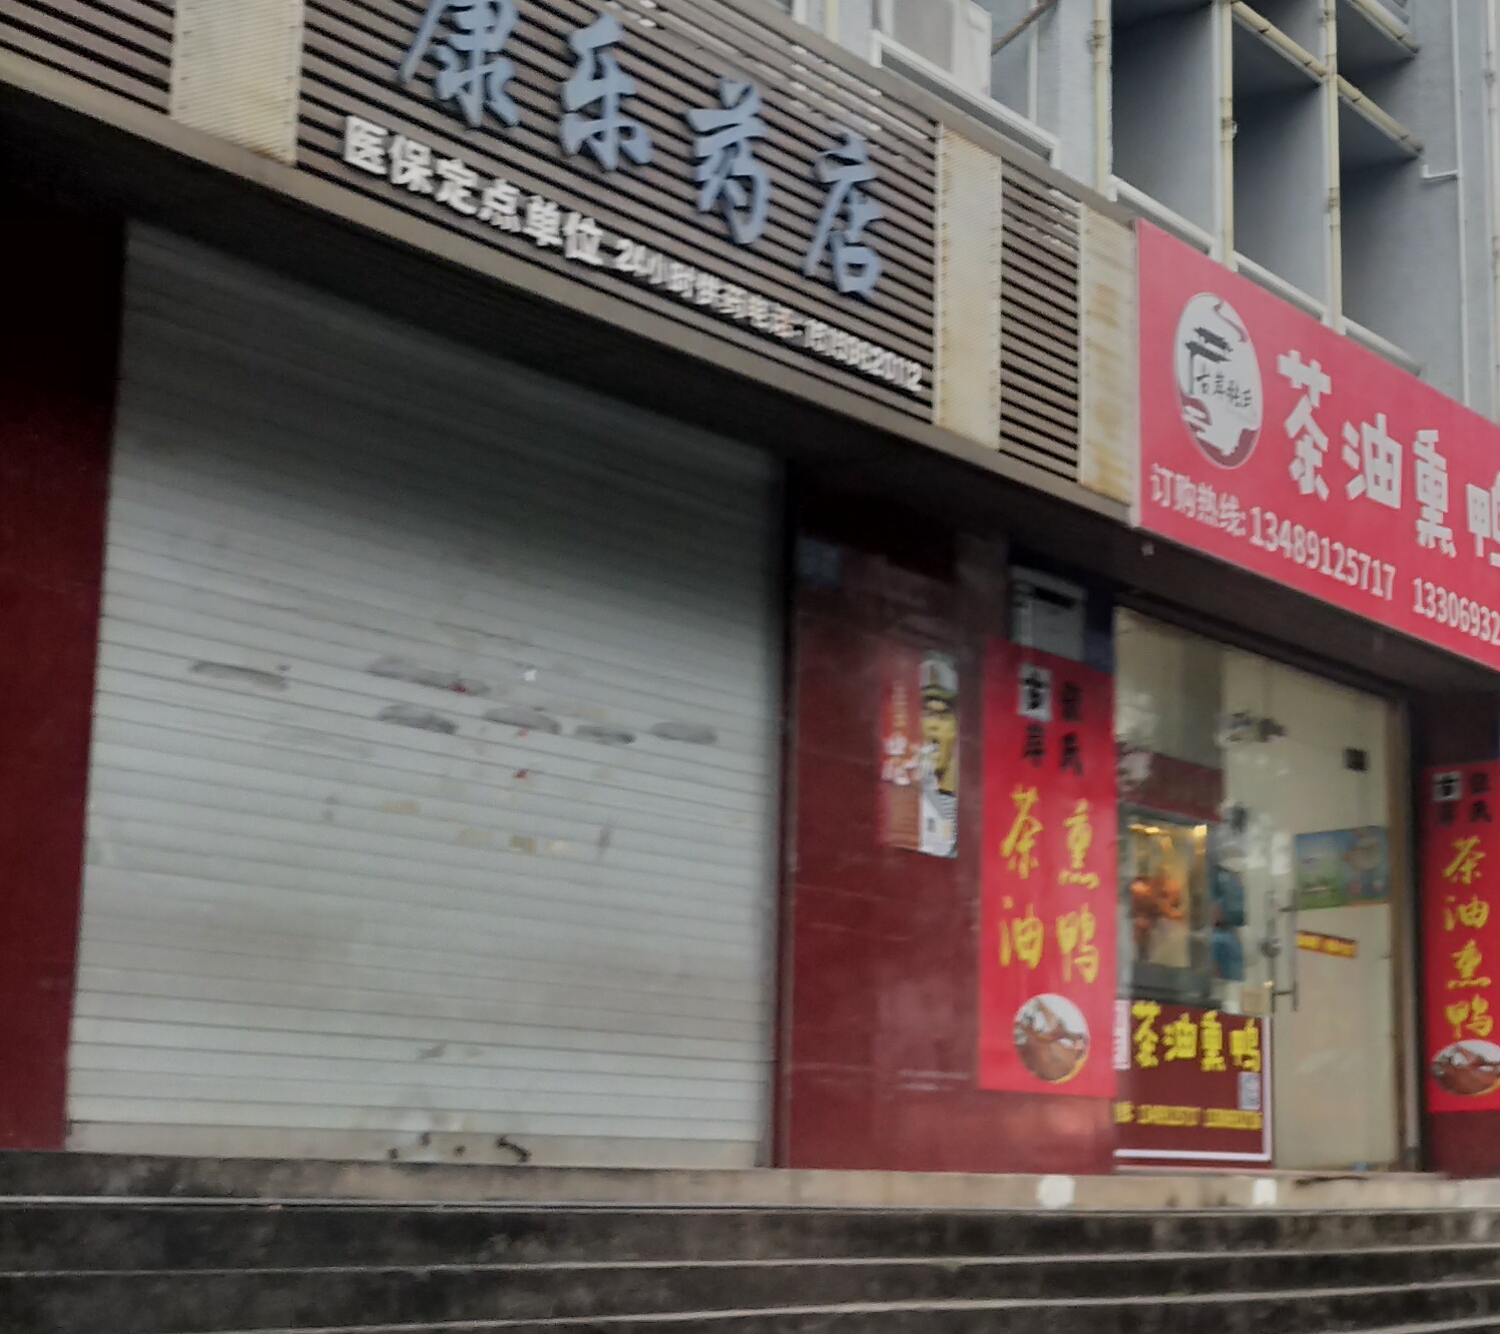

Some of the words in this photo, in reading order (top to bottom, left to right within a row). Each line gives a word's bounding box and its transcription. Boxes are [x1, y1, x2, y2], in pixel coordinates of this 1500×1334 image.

[344, 115, 604, 266] 医保定点单位
[1249, 505, 1397, 602] 13489125717
[1443, 835, 1493, 1040] 茶油熏鸭
